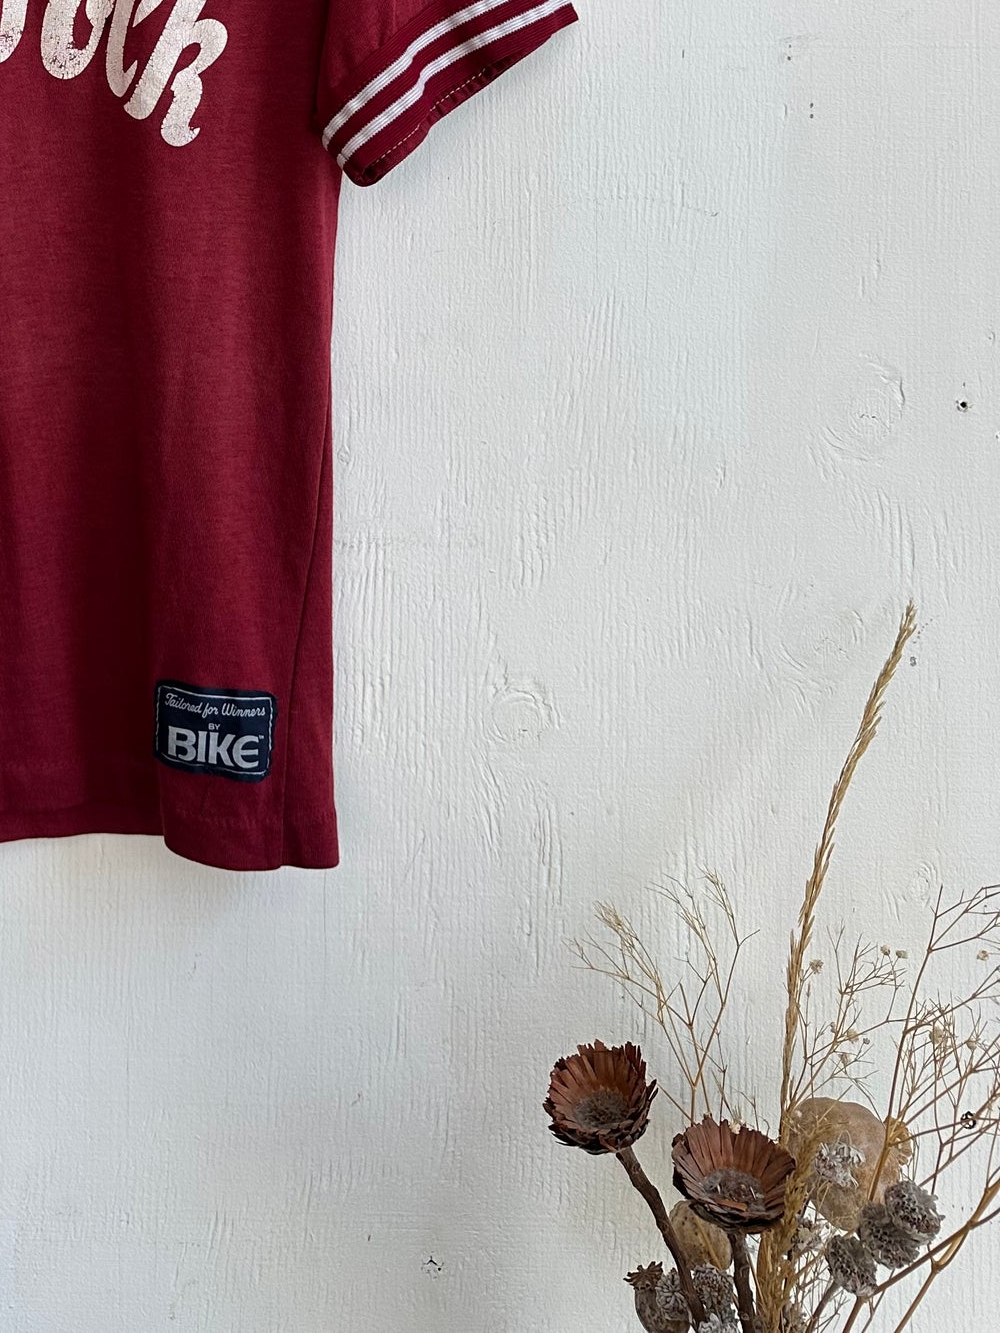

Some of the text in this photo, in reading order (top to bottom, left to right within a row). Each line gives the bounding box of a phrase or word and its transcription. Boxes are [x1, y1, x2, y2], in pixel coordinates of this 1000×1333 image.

[164, 692, 266, 719] Tailored for Winners
[208, 722, 221, 731] BY
[167, 725, 260, 769] BIKE
